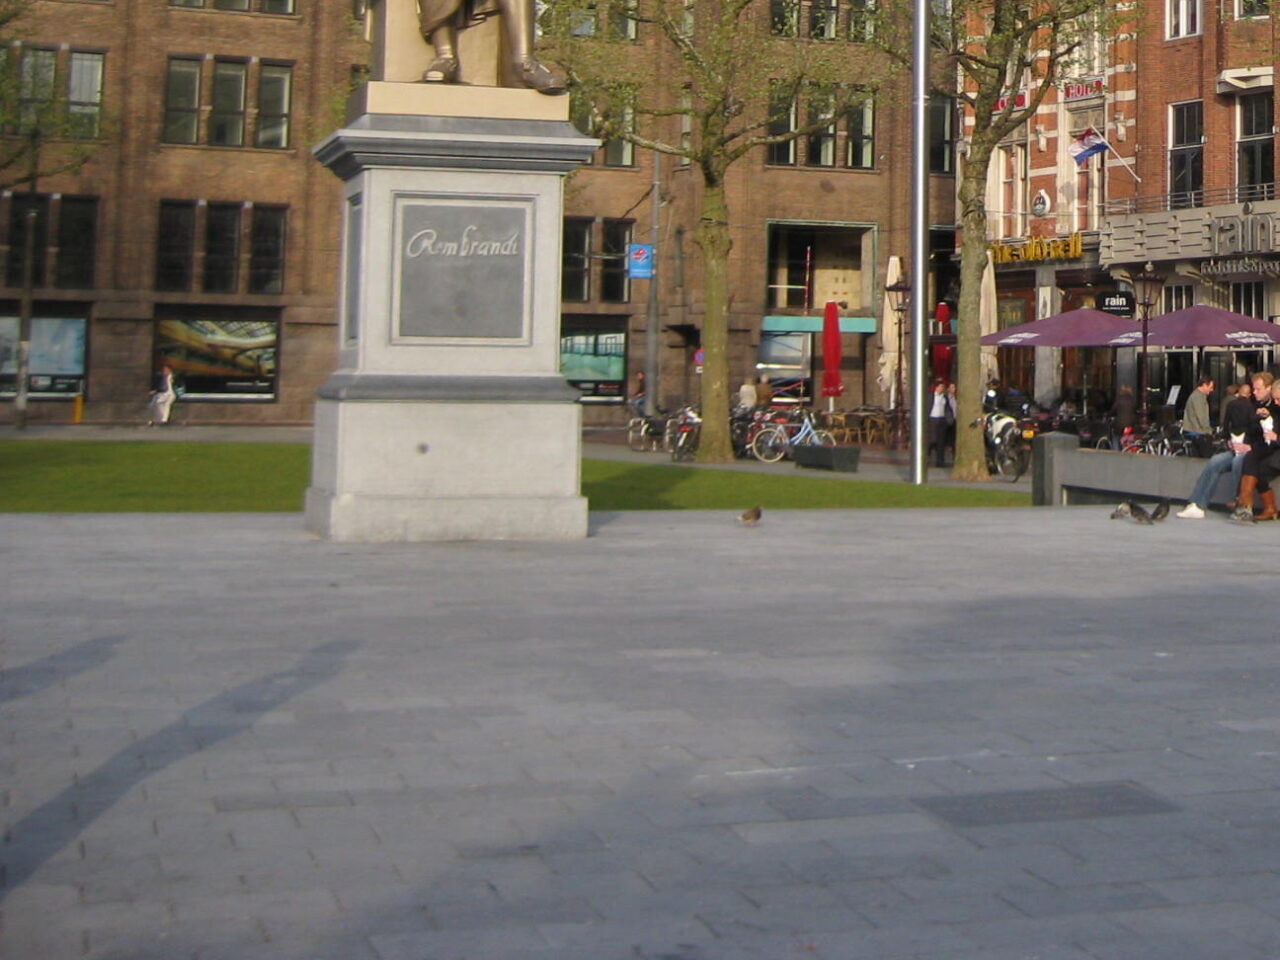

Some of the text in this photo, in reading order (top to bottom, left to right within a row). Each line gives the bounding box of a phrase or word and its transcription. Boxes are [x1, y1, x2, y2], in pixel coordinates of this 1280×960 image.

[406, 225, 519, 257] Rembrandt
[1212, 201, 1275, 256] rain
[1105, 294, 1127, 306] rain
